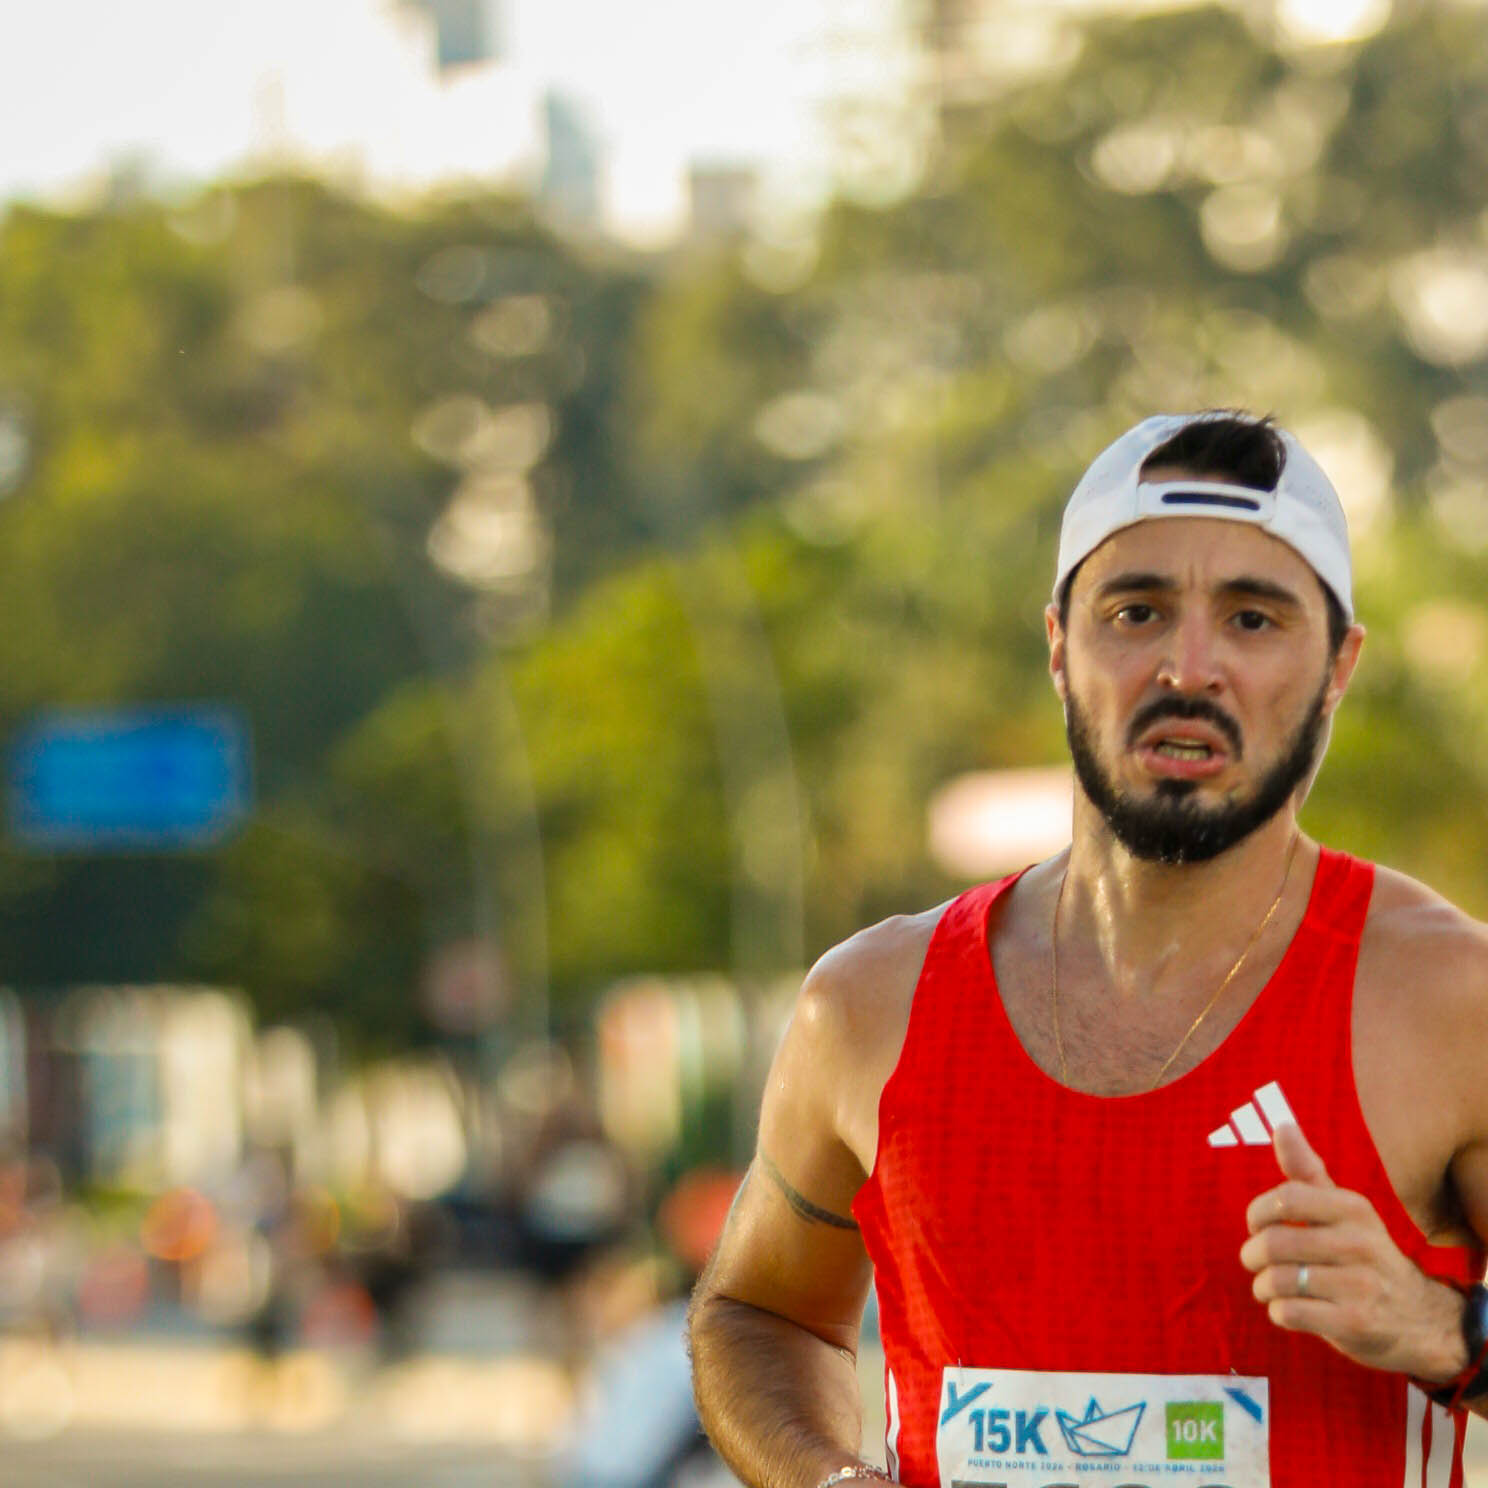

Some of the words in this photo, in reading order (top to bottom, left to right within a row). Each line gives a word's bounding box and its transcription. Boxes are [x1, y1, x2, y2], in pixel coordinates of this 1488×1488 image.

[968, 1408, 1050, 1455] 15K
[1171, 1419, 1217, 1442] 10K
[1075, 1462, 1121, 1472] ROSARIO
